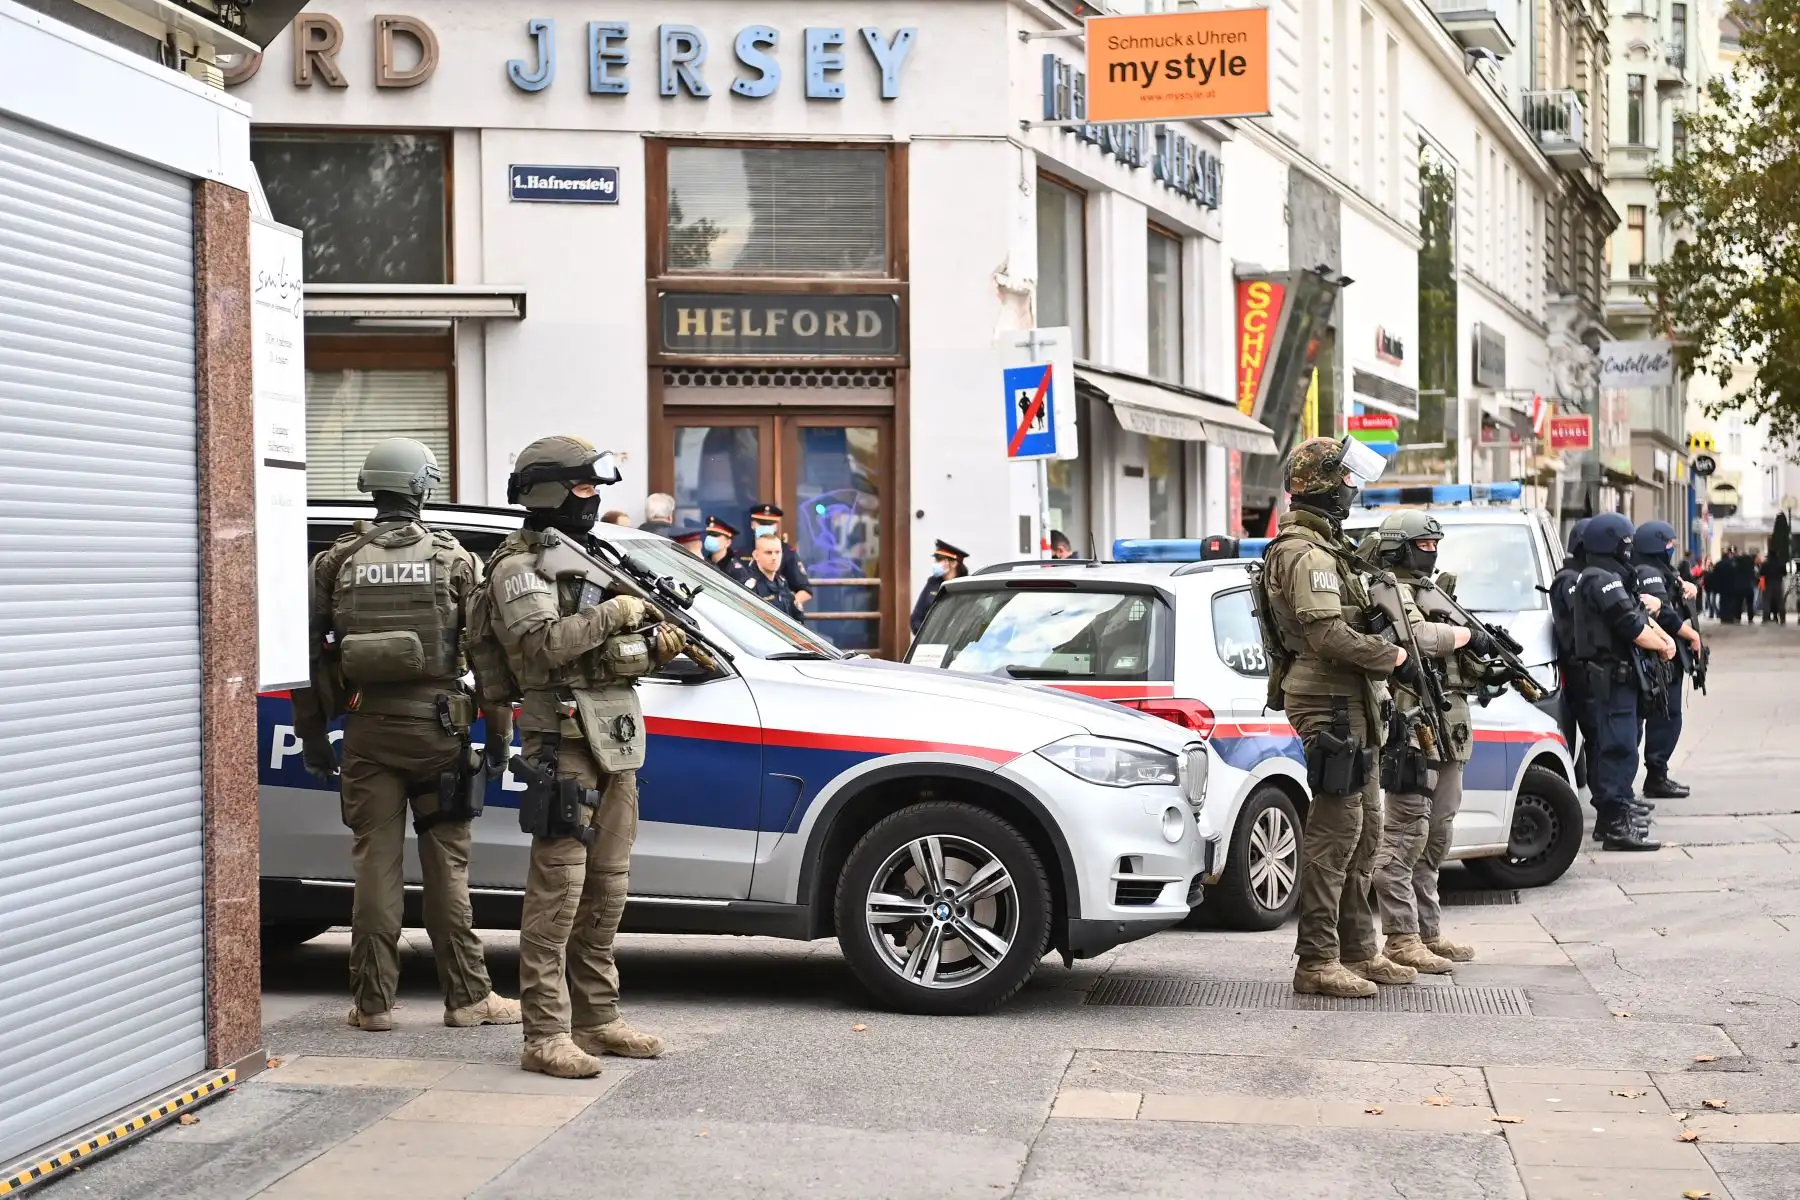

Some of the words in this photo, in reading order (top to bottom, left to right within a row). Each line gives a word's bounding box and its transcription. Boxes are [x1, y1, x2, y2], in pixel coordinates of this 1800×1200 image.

[1108, 33, 1184, 50] Schmuck
[1186, 35, 1195, 46] &
[1197, 30, 1248, 46] Uhren
[507, 18, 917, 100] JERSEY
[1109, 59, 1159, 89] my
[1165, 49, 1247, 86] style
[676, 308, 883, 338] HELFORD
[355, 561, 432, 585] POLIZEI
[1238, 643, 1266, 670] 133
